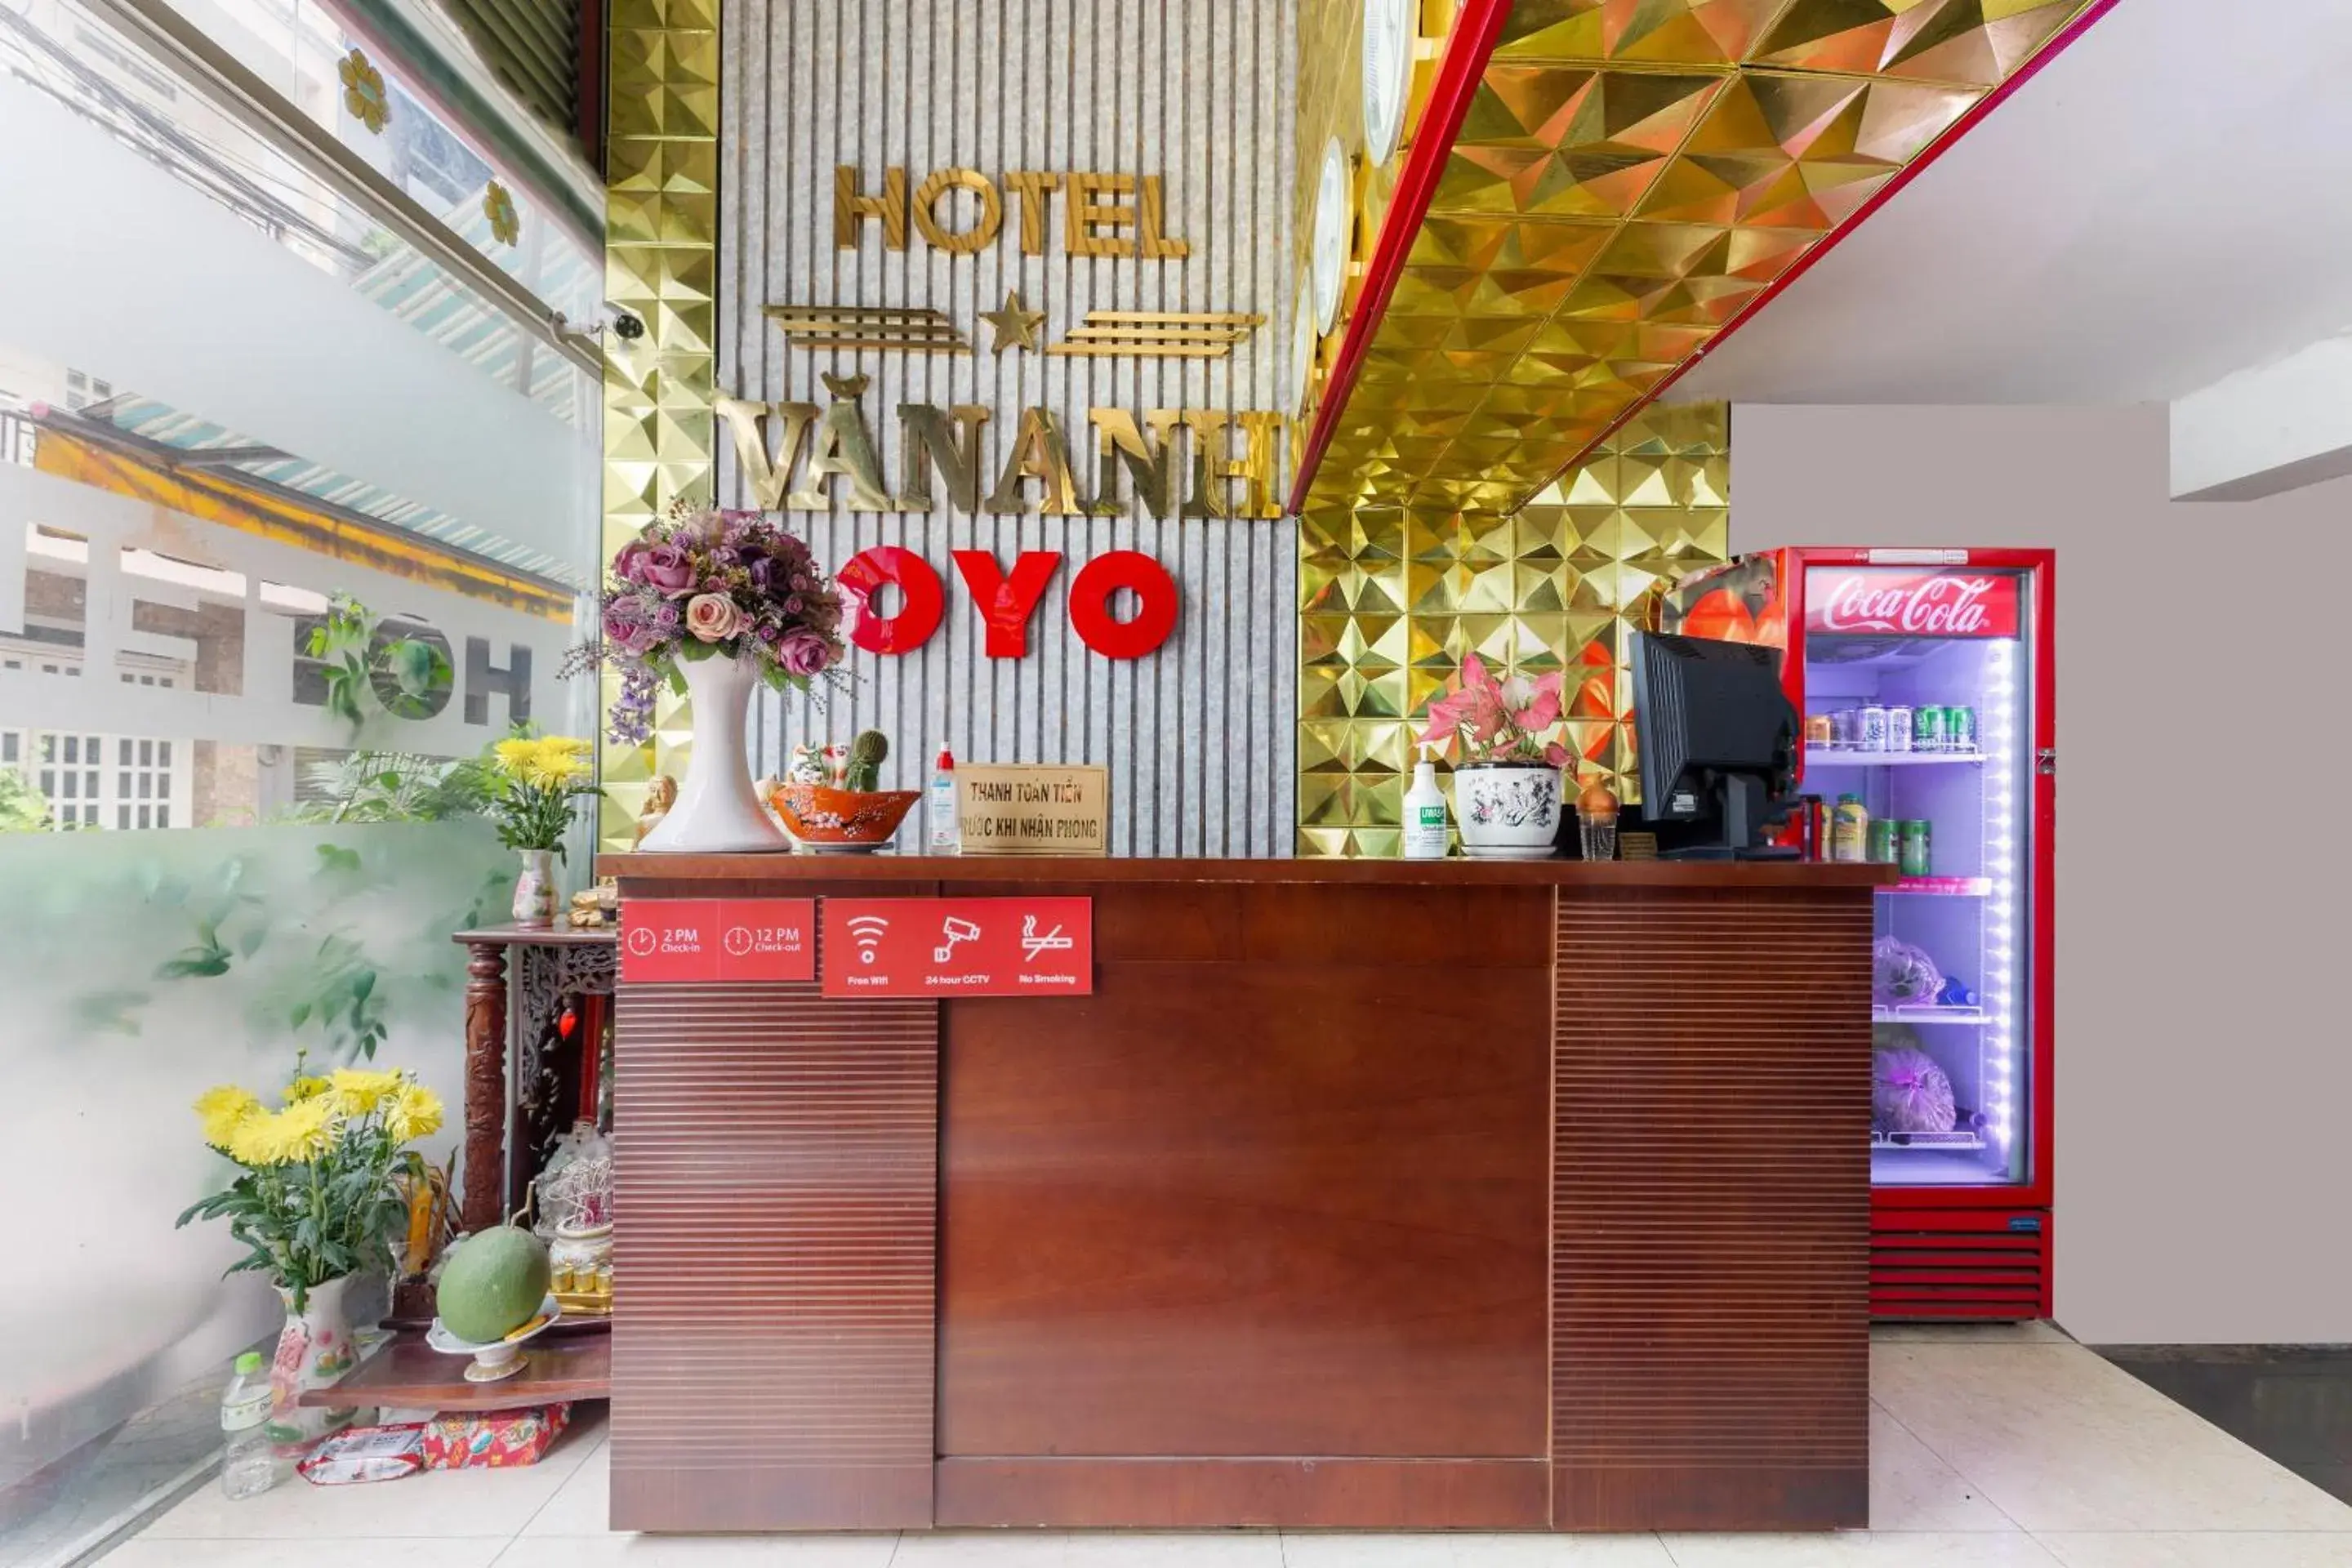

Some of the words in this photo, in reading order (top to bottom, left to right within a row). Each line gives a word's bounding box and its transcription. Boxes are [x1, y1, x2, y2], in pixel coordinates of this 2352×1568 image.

[834, 164, 1189, 259] HOTEL
[836, 546, 1178, 660] OYO
[970, 782, 1012, 802] THANH
[1017, 777, 1049, 803] TOÁN
[996, 817, 1017, 837] KHI
[1020, 813, 1053, 842] NHẬN
[663, 929, 672, 942] 2
[675, 929, 697, 942] PM
[756, 929, 773, 942] 12
[777, 928, 800, 942] PM
[661, 942, 701, 953] Check-in
[755, 942, 801, 952] Check-out
[848, 976, 869, 986] Free
[925, 975, 938, 985] 24
[939, 975, 961, 984] hour
[963, 974, 991, 984] CCTV
[1018, 974, 1033, 984] No
[1034, 974, 1076, 985] Smoking
